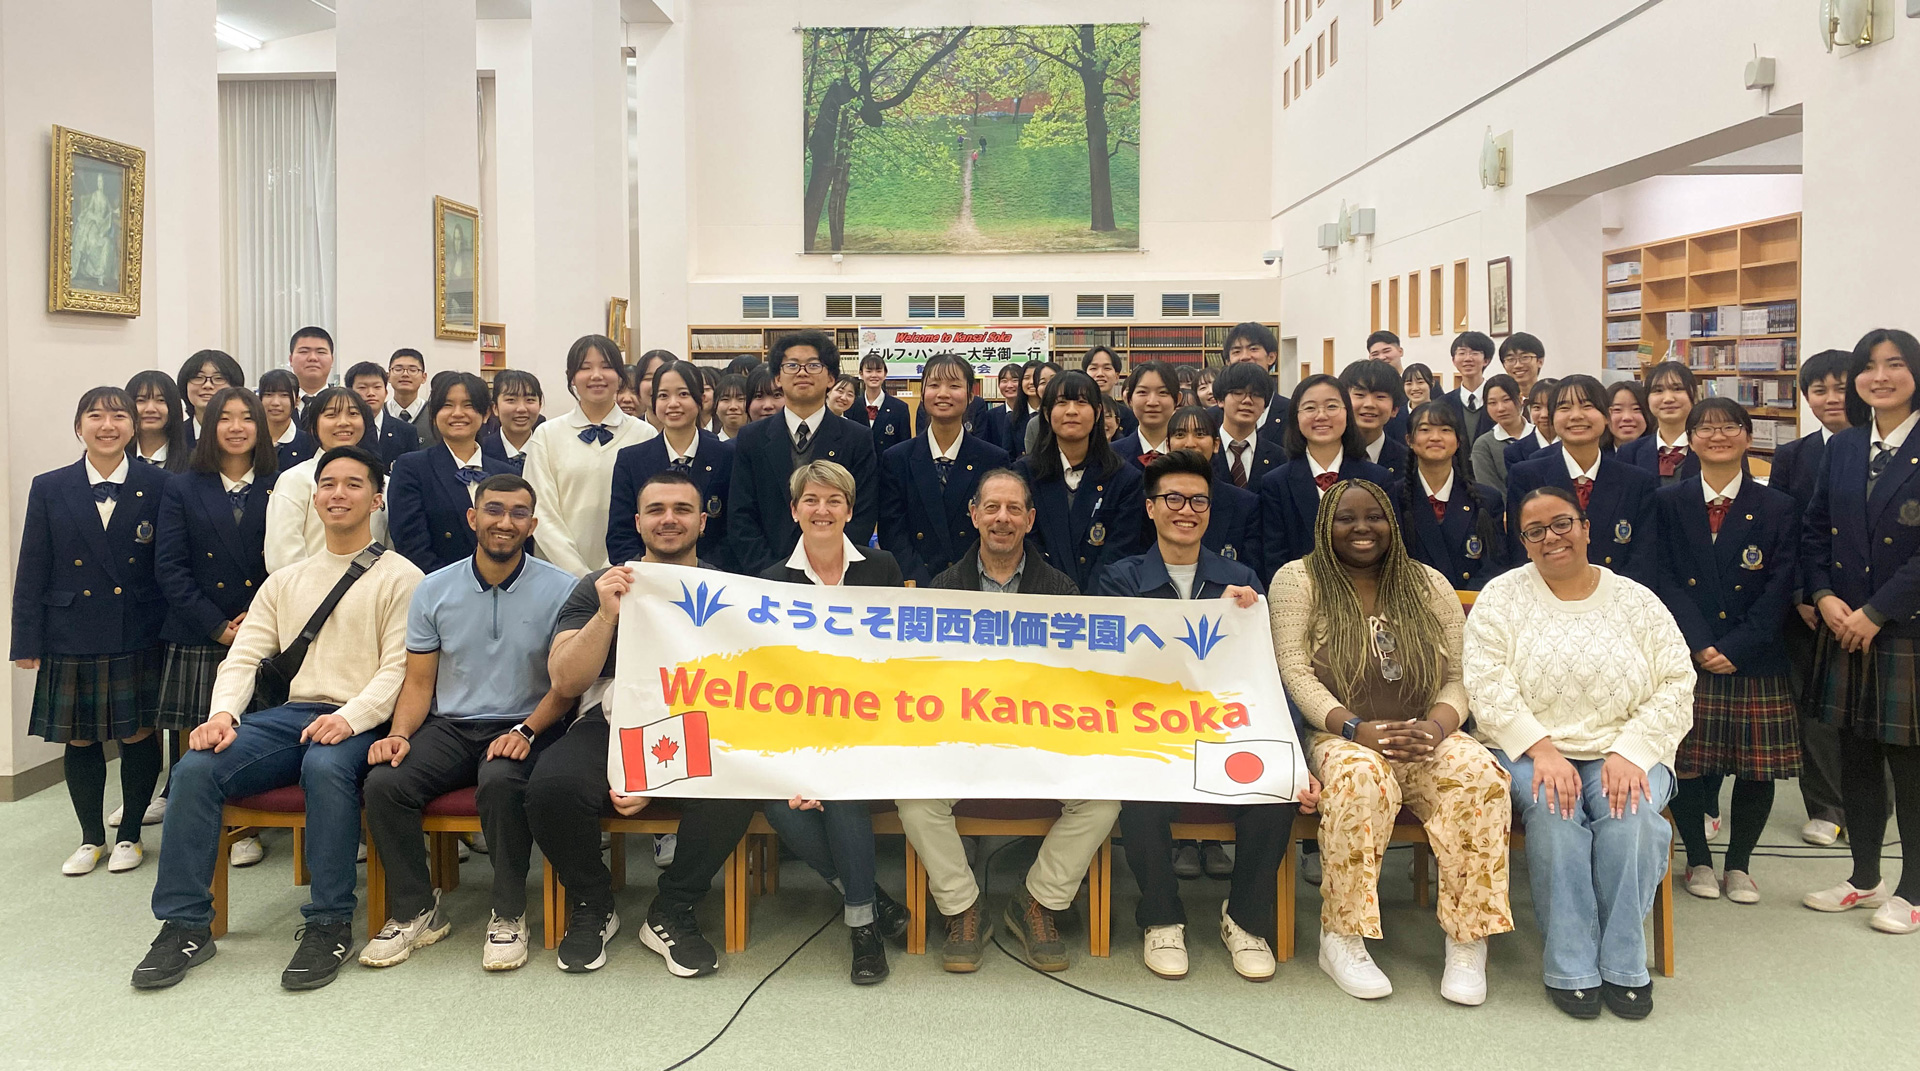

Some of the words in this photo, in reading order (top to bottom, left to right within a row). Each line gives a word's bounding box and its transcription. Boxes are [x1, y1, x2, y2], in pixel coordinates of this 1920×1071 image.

[895, 332, 940, 343] Welcome
[940, 332, 952, 343] to
[952, 331, 988, 343] Kansai
[987, 331, 1013, 343] Soka
[747, 595, 1166, 653] ようこそ関西創価学園へ
[659, 667, 880, 721] Welcome
[894, 690, 945, 722] to
[961, 687, 1119, 733] Kansai
[1132, 700, 1251, 733] Soka
